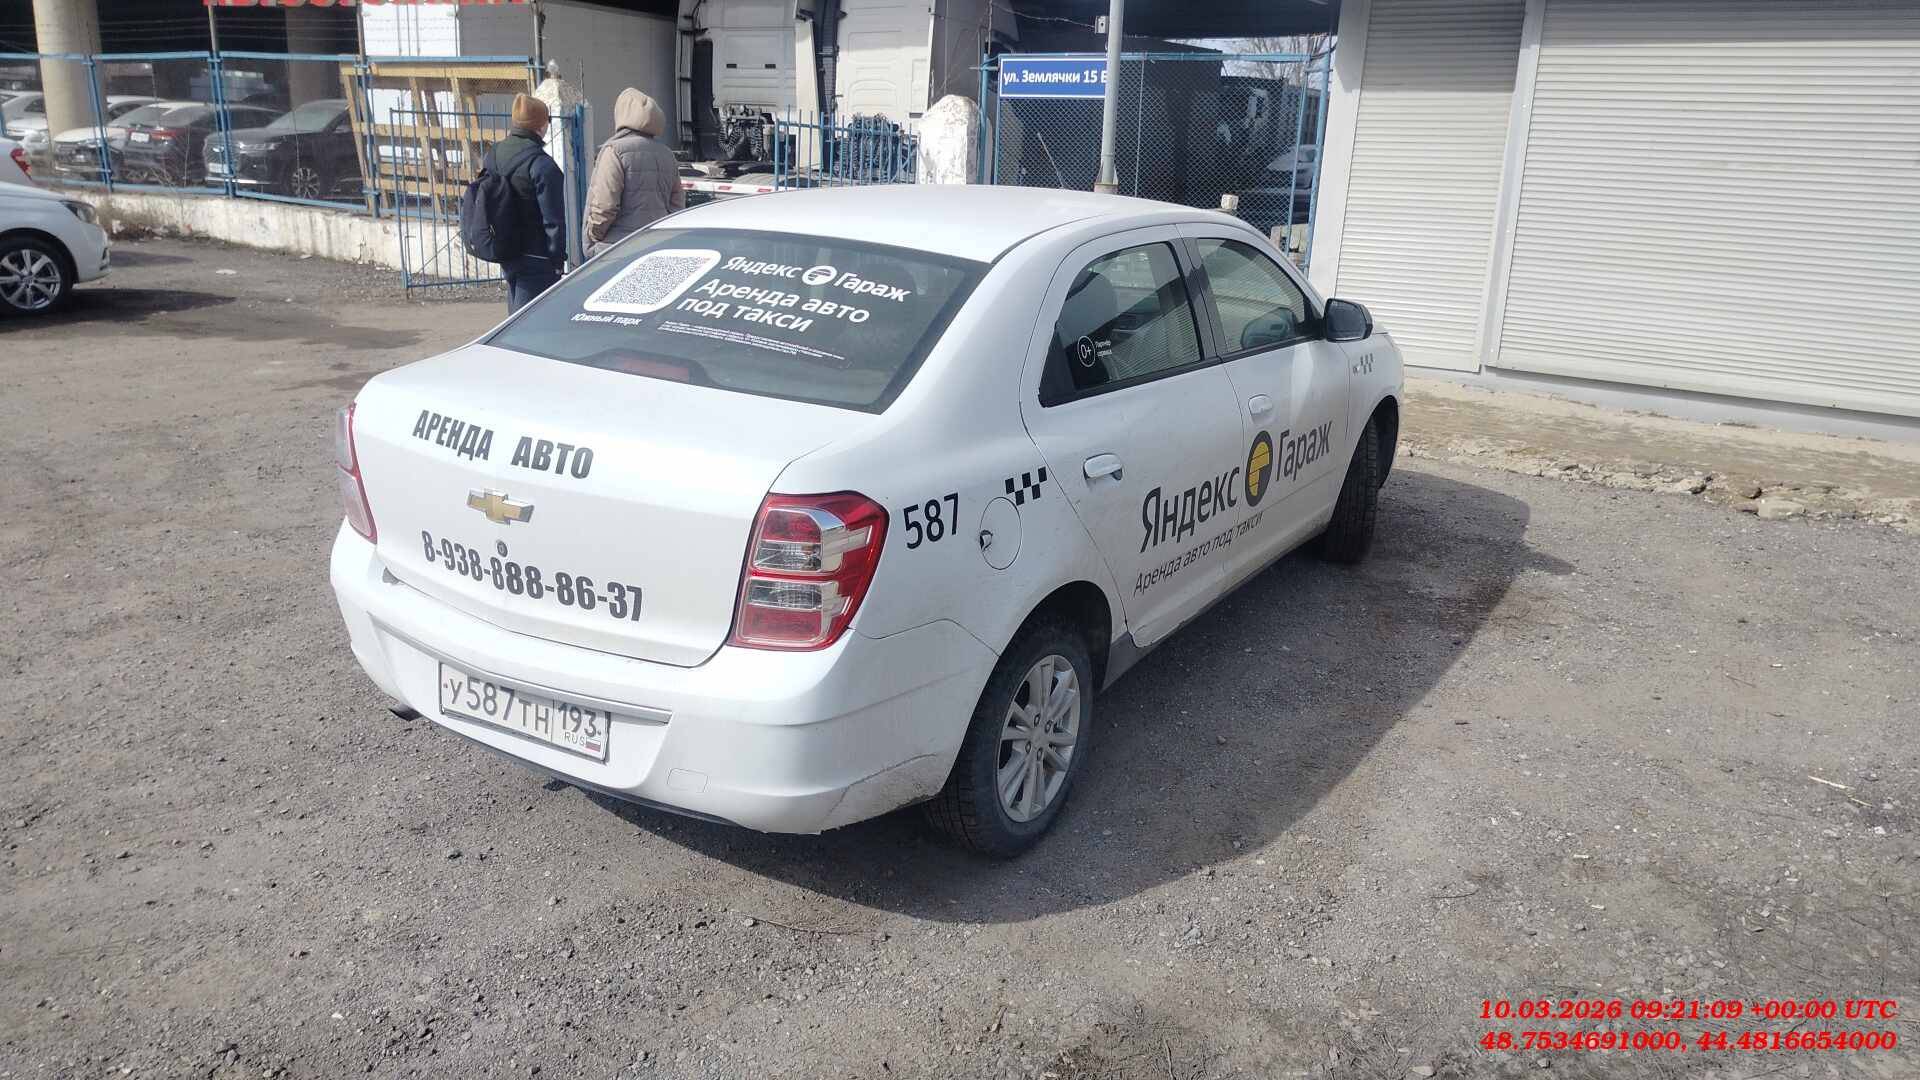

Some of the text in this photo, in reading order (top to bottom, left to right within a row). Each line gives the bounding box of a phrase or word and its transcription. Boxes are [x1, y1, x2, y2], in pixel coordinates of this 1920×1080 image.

[1003, 71, 1019, 86] ул.
[1022, 69, 1081, 84] Землячки
[1083, 70, 1099, 84] 15
[695, 279, 870, 324] Аренда авто
[722, 256, 912, 303] Яндекс Гараж
[677, 298, 814, 333] под такси
[412, 409, 594, 479] АРЕНДА АВТО
[1140, 421, 1333, 553] Яндекс Гараж
[903, 492, 959, 551] 587
[421, 530, 643, 622] 8-938-888-86-37
[1133, 513, 1263, 599] Аренда авто под такси
[449, 675, 597, 738] У587ТН 193
[564, 731, 586, 746] RUS
